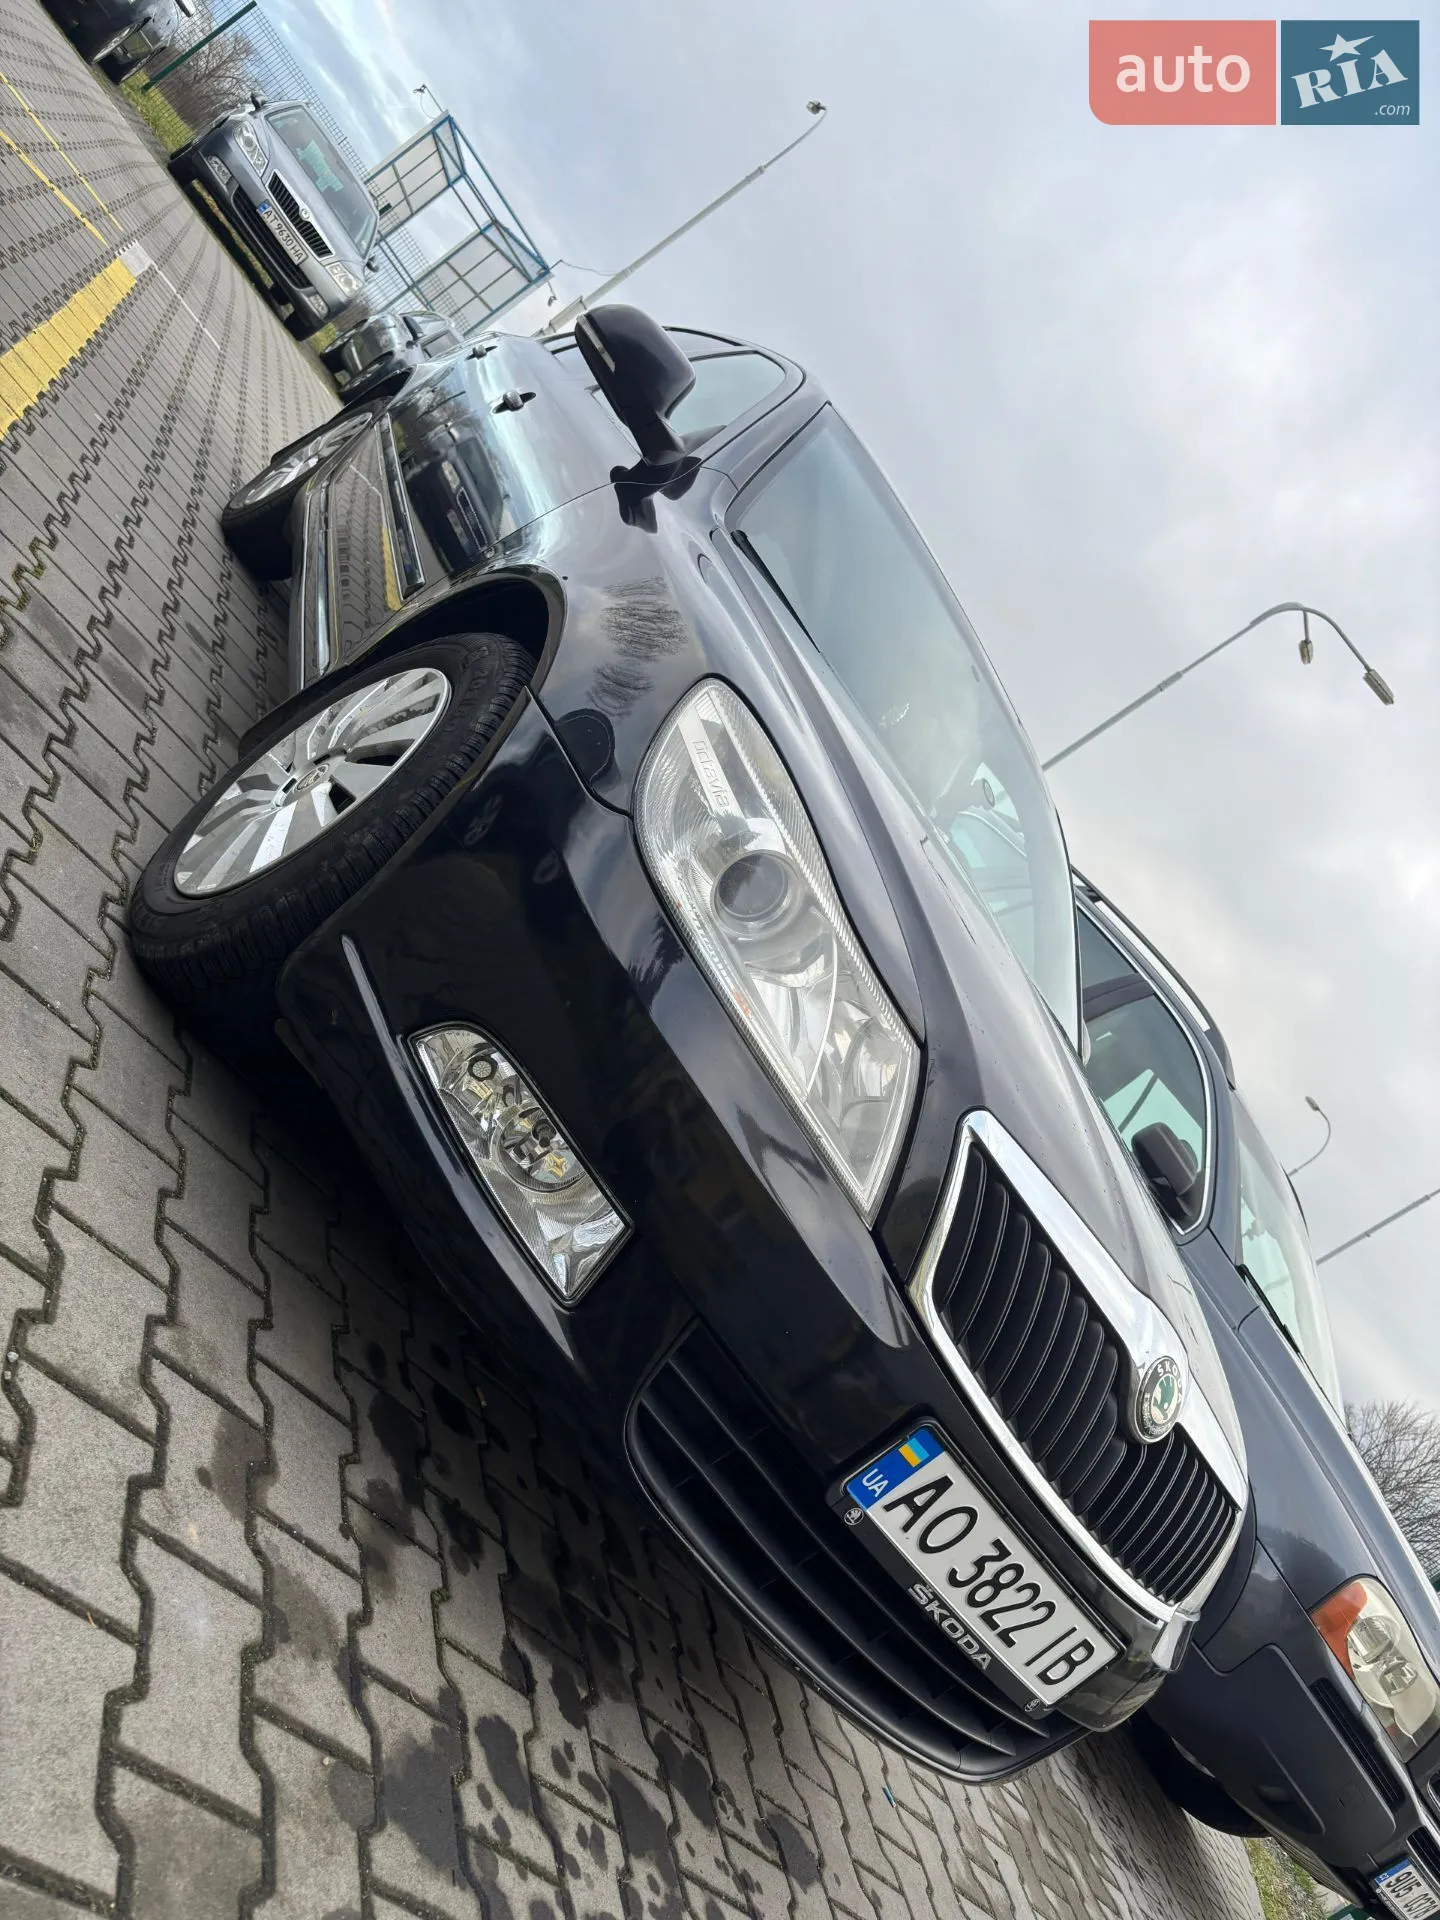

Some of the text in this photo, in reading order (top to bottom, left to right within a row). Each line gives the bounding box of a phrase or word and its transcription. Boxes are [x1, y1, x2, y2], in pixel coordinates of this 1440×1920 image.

[264, 211, 304, 260] AT 9630 HA
[862, 1468, 889, 1498] UA
[883, 1475, 1095, 1686] AO 3822 IB
[907, 1583, 993, 1671] ŠKODA
[1385, 1871, 1421, 1898] 9U5
